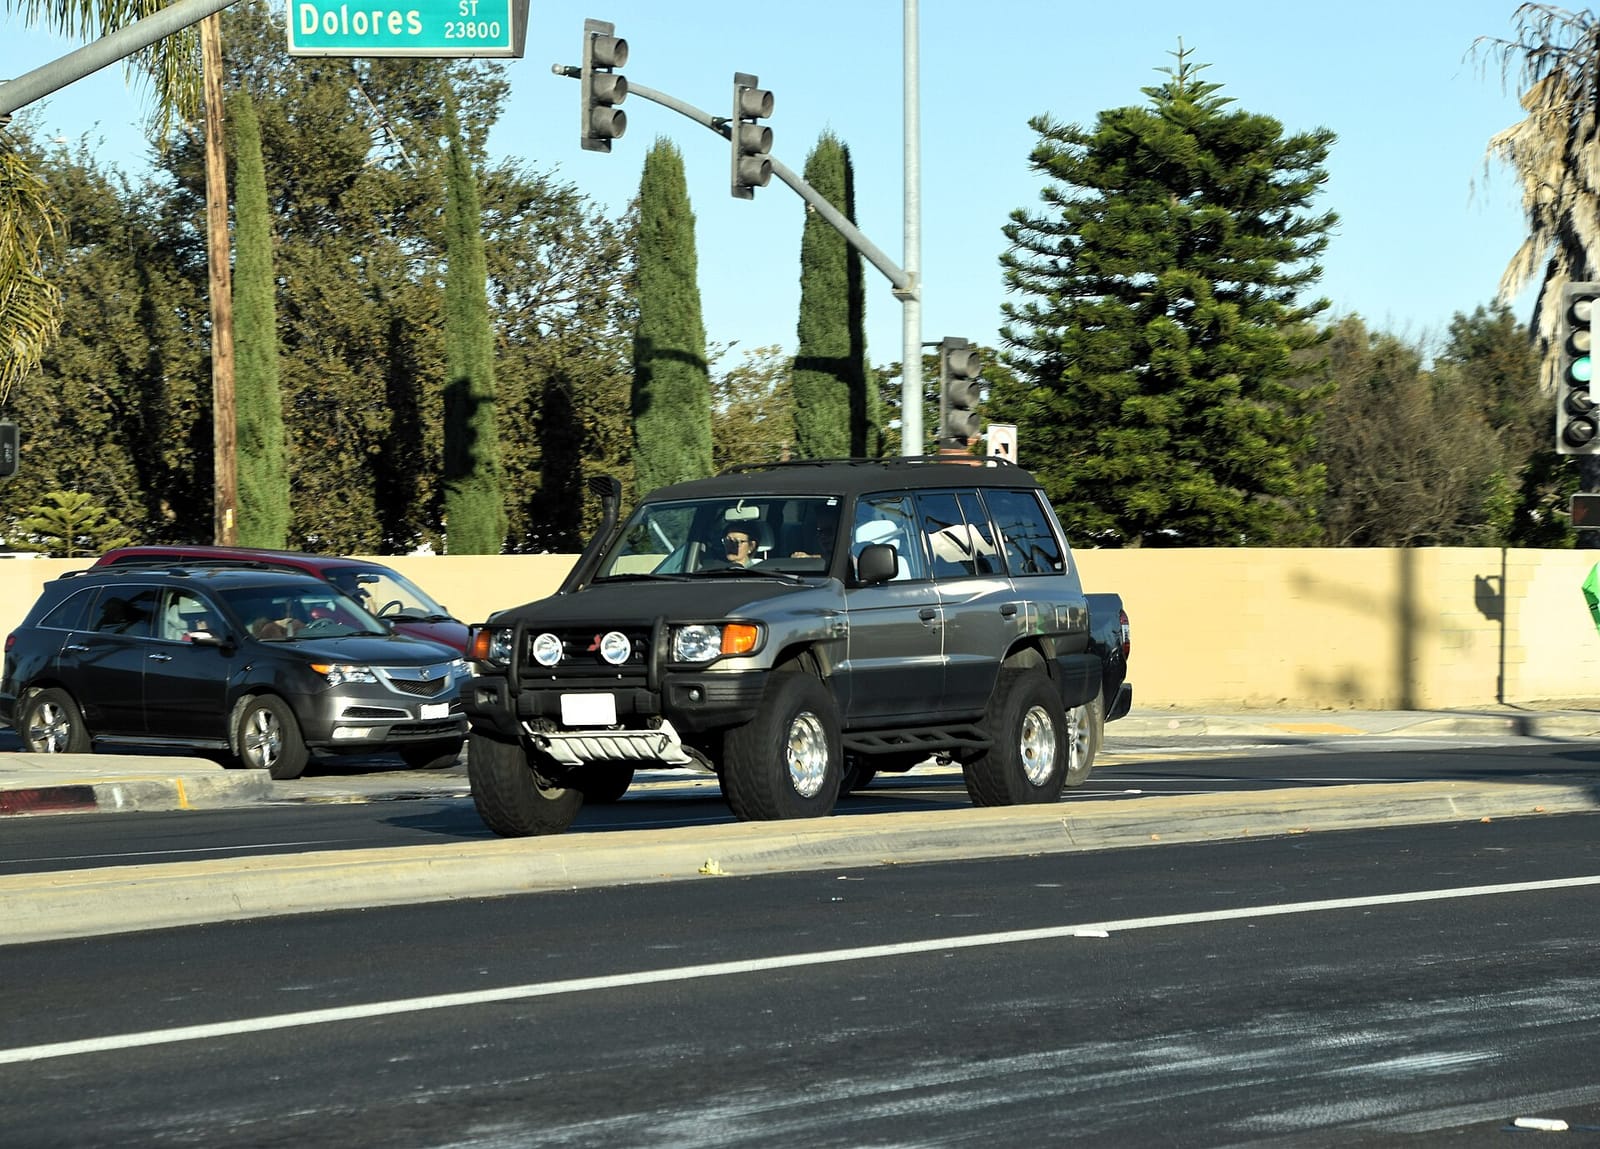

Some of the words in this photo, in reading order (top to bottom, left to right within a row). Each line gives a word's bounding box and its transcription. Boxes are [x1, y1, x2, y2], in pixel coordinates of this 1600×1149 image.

[459, 0, 479, 16] ST
[301, 3, 423, 35] Dolores
[444, 21, 500, 39] 23800
